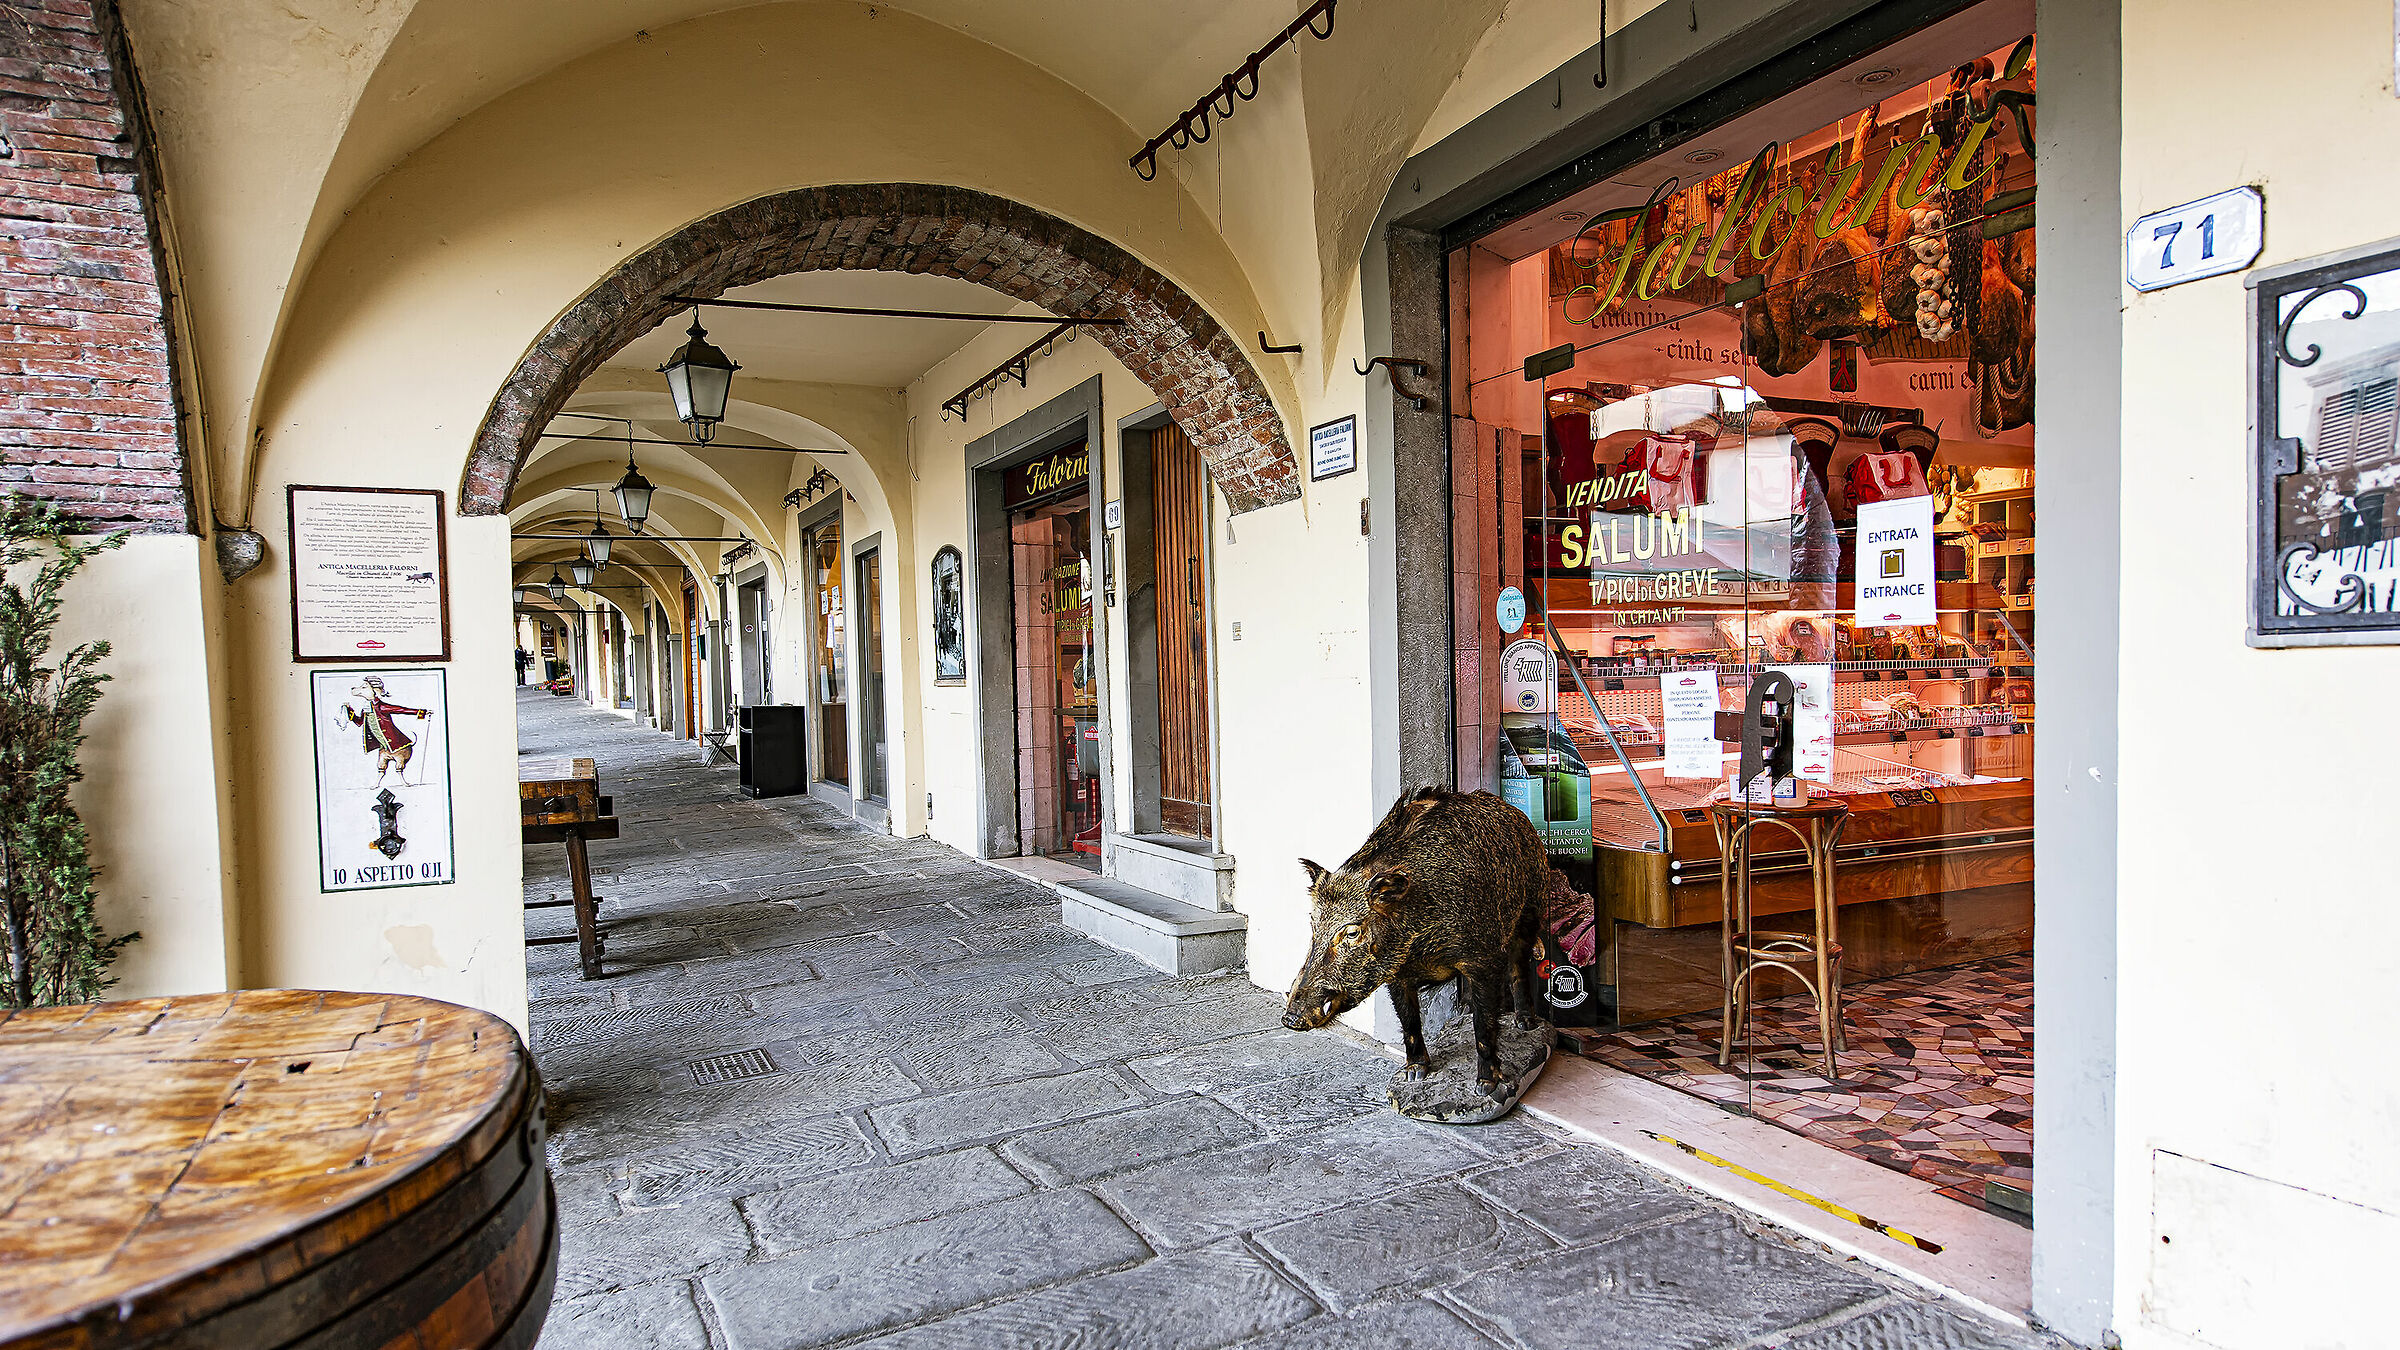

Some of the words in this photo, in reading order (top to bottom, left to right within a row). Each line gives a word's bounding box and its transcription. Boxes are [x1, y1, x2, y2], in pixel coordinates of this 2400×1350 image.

[1563, 34, 2034, 325] Falorni
[2153, 213, 2215, 270] 71
[1666, 338, 1714, 363] cinta
[1909, 364, 1955, 392] carni
[1026, 441, 1090, 495] Falorni
[1565, 468, 1649, 508] VENDITA
[1108, 505, 1119, 523] 69
[1560, 504, 1705, 569] SALUMI
[1868, 527, 1919, 544] ENTRATA
[1588, 575, 1639, 606] TIPICI
[1654, 567, 1719, 601] GREVE
[1863, 583, 1925, 599] ENTRANCE
[1040, 586, 1081, 615] SALUMI
[1612, 611, 1626, 626] IN
[1630, 606, 1686, 625] CHIANTI
[1541, 837, 1583, 846] SOLTANTO
[1549, 828, 1563, 837] CHI
[1564, 827, 1591, 836] CERCA
[1558, 846, 1588, 856] BUONE!
[332, 868, 347, 885] IO
[354, 863, 414, 885] ASPETTO
[421, 861, 442, 878] QUI
